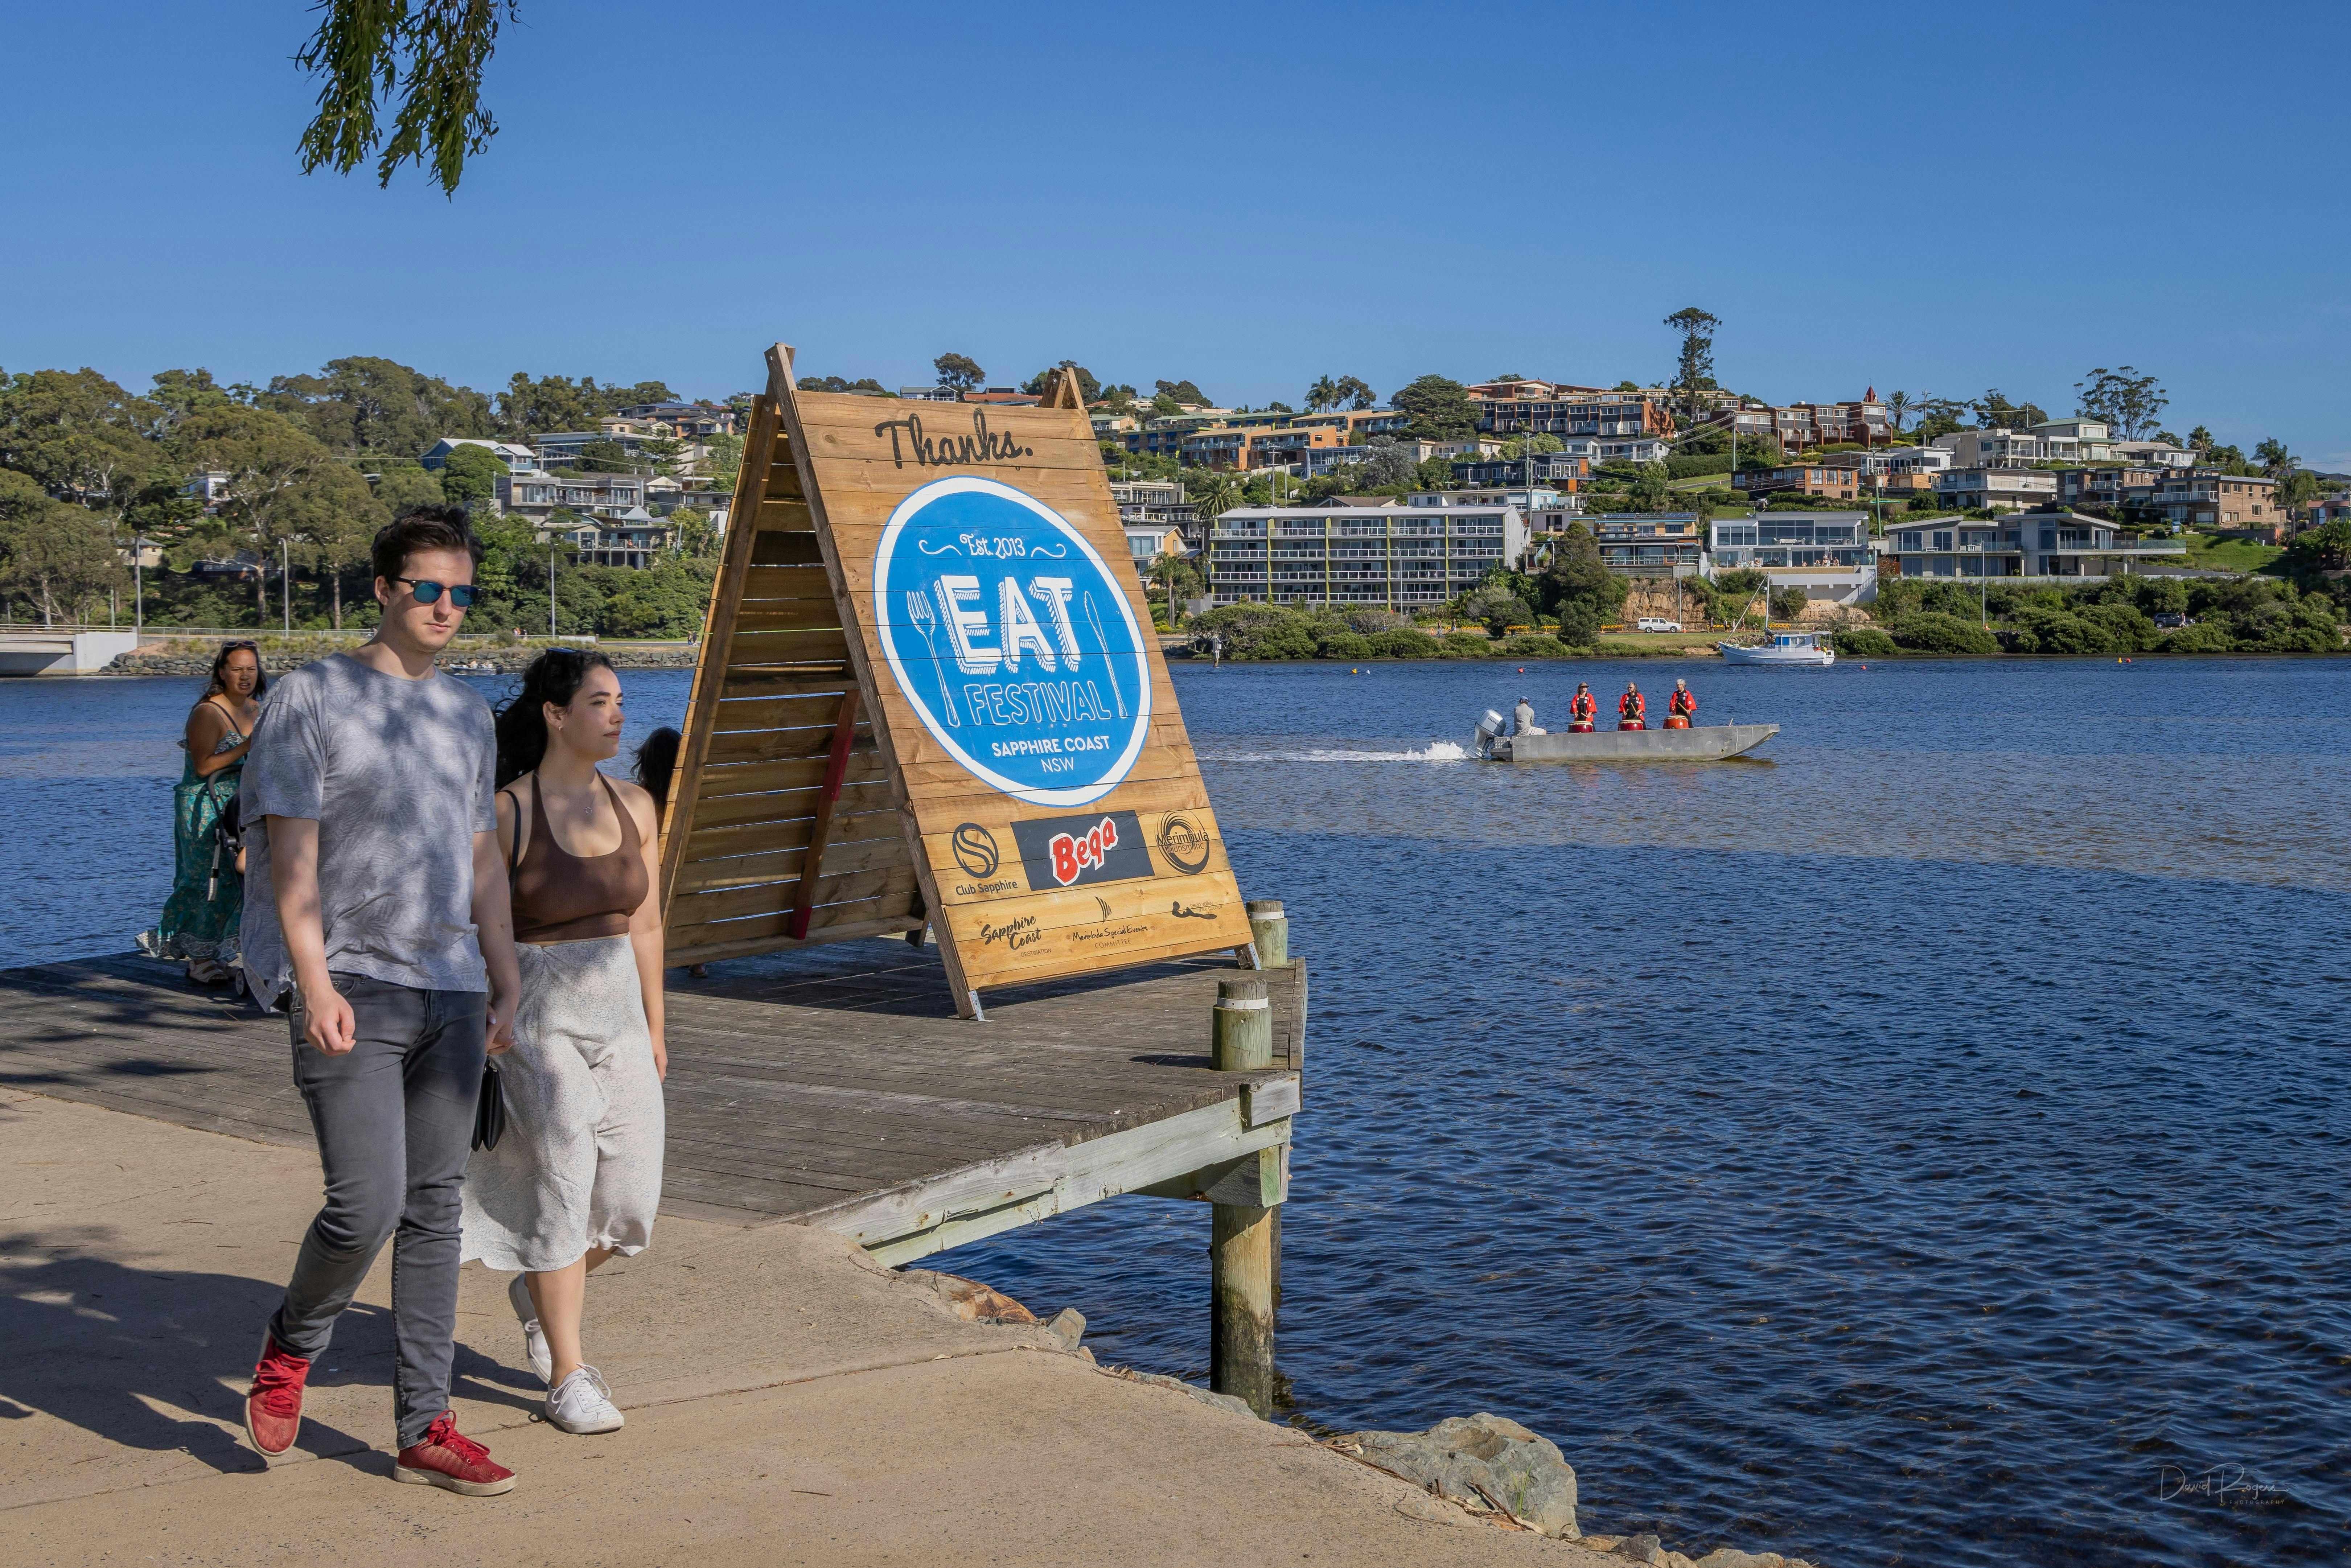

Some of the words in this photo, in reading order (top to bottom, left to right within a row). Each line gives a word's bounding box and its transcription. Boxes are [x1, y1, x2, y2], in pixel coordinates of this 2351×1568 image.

[875, 408, 1033, 469] Thanks.
[959, 534, 993, 556] Est.
[994, 538, 1026, 559] 2013
[934, 575, 1081, 675] EAT
[964, 680, 1112, 725] FESTIVAL
[1488, 717, 1502, 728] HONDA
[992, 737, 1062, 757] SAPPHIRE
[1064, 735, 1110, 752] COAST
[1040, 757, 1074, 773] NSW
[1156, 830, 1209, 845] Merimbula
[1166, 843, 1192, 853] Tourism
[1049, 816, 1118, 886] Bega
[955, 884, 976, 896] Club
[977, 880, 1018, 894] Sapphire
[981, 915, 1036, 945] Sapphire
[1010, 927, 1041, 950] Coast
[1021, 948, 1052, 957] DESTINATION
[1095, 938, 1131, 949] COMMITTEE
